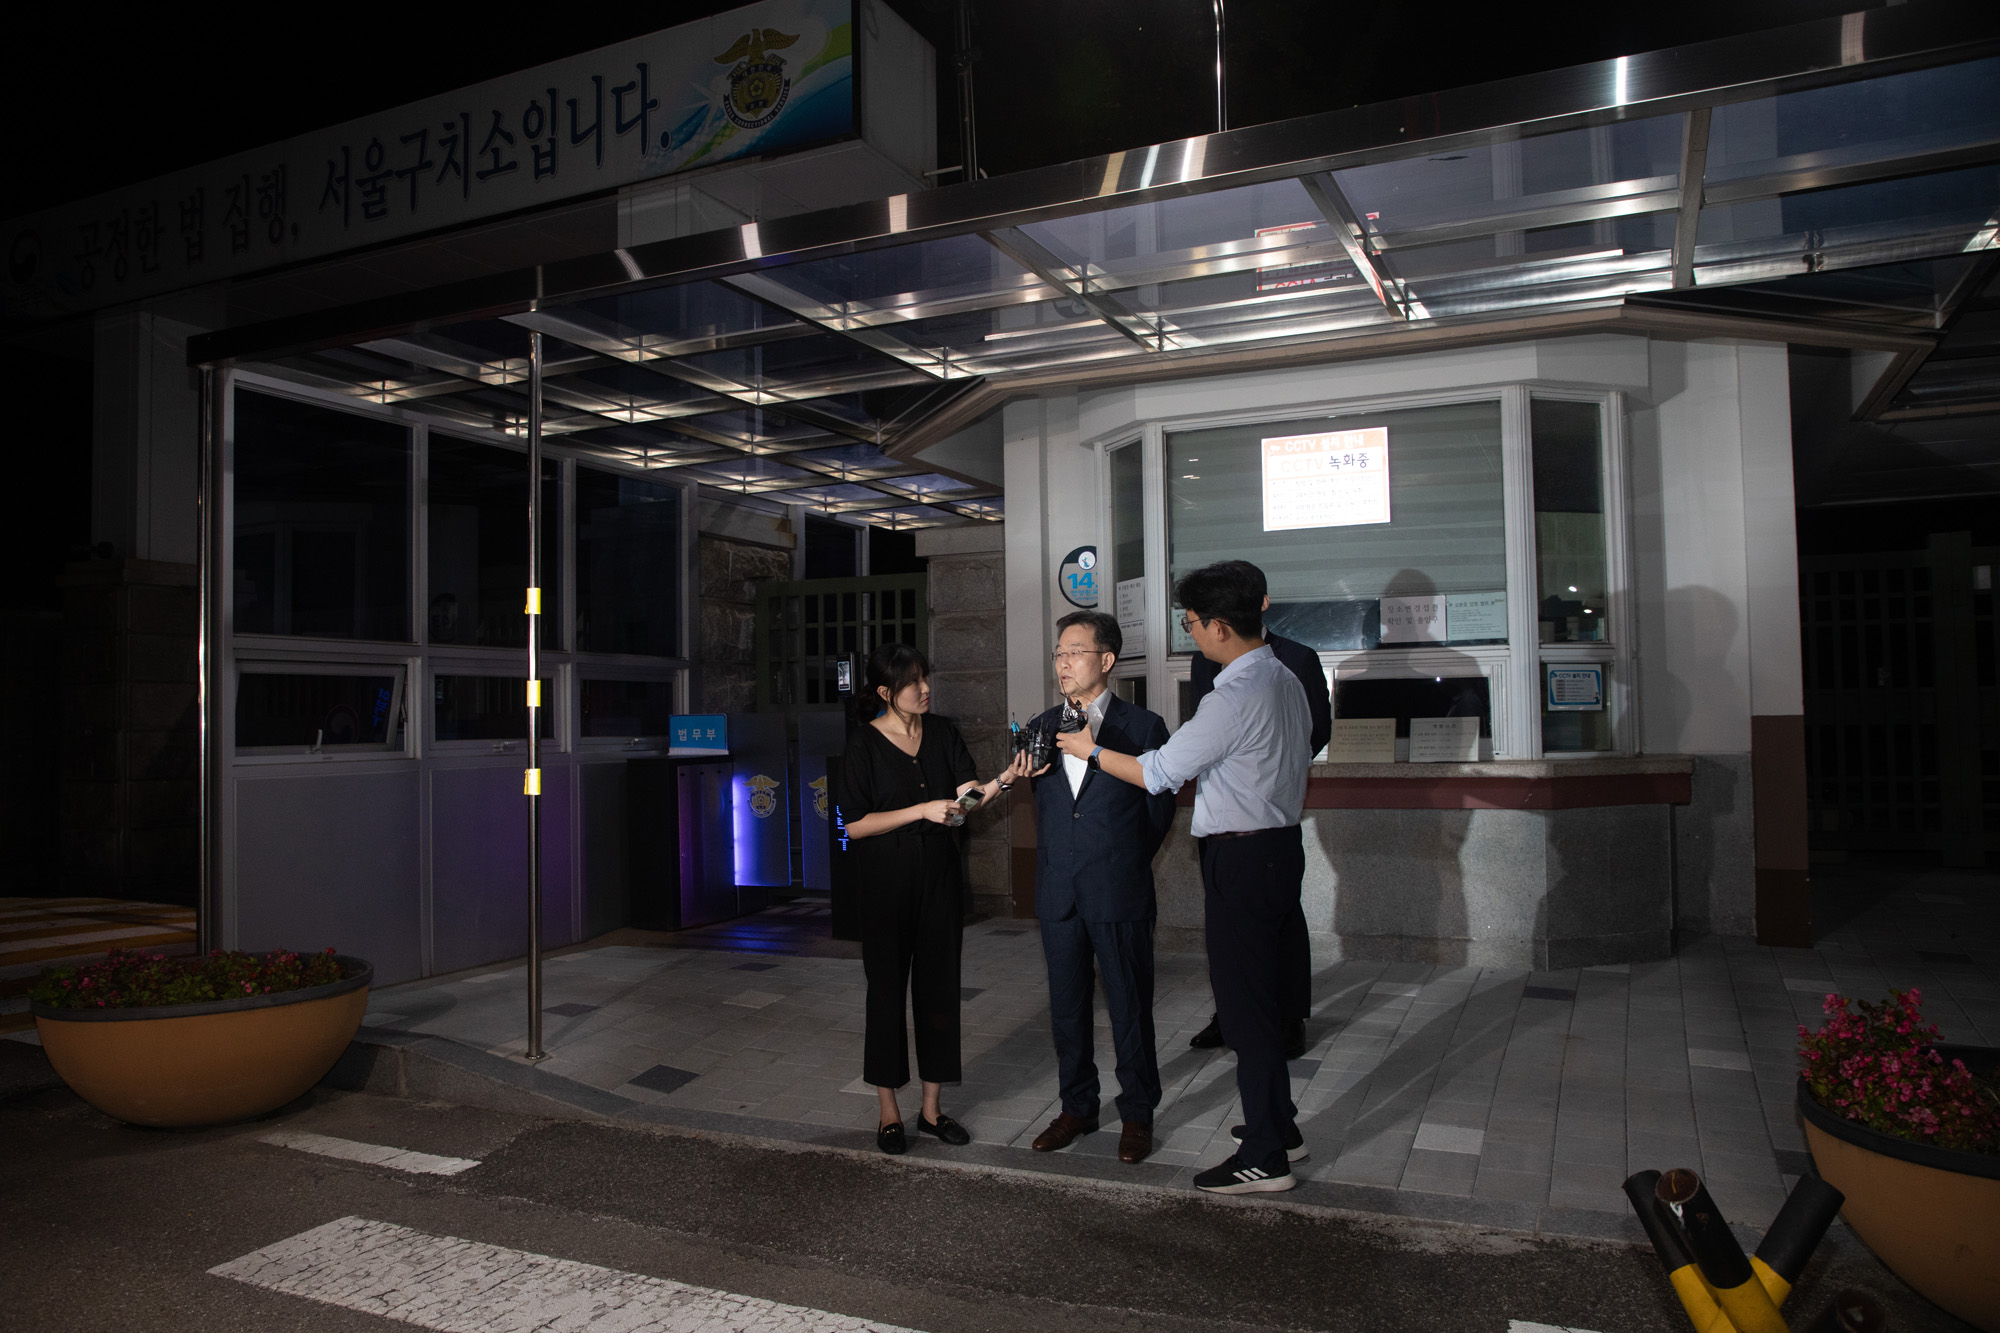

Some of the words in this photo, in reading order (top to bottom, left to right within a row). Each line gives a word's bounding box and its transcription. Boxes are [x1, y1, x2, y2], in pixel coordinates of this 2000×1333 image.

[72, 200, 165, 292] 공정한
[178, 186, 208, 265] 법
[222, 163, 301, 258] 집행,
[318, 62, 673, 230] 서울구치소입니다.
[1285, 438, 1317, 453] CCTV
[1343, 433, 1365, 449] 안내
[1281, 457, 1324, 473] CCTV
[1328, 452, 1370, 470] 녹화중
[1066, 571, 1099, 590] 14
[677, 728, 717, 741] 법무부
